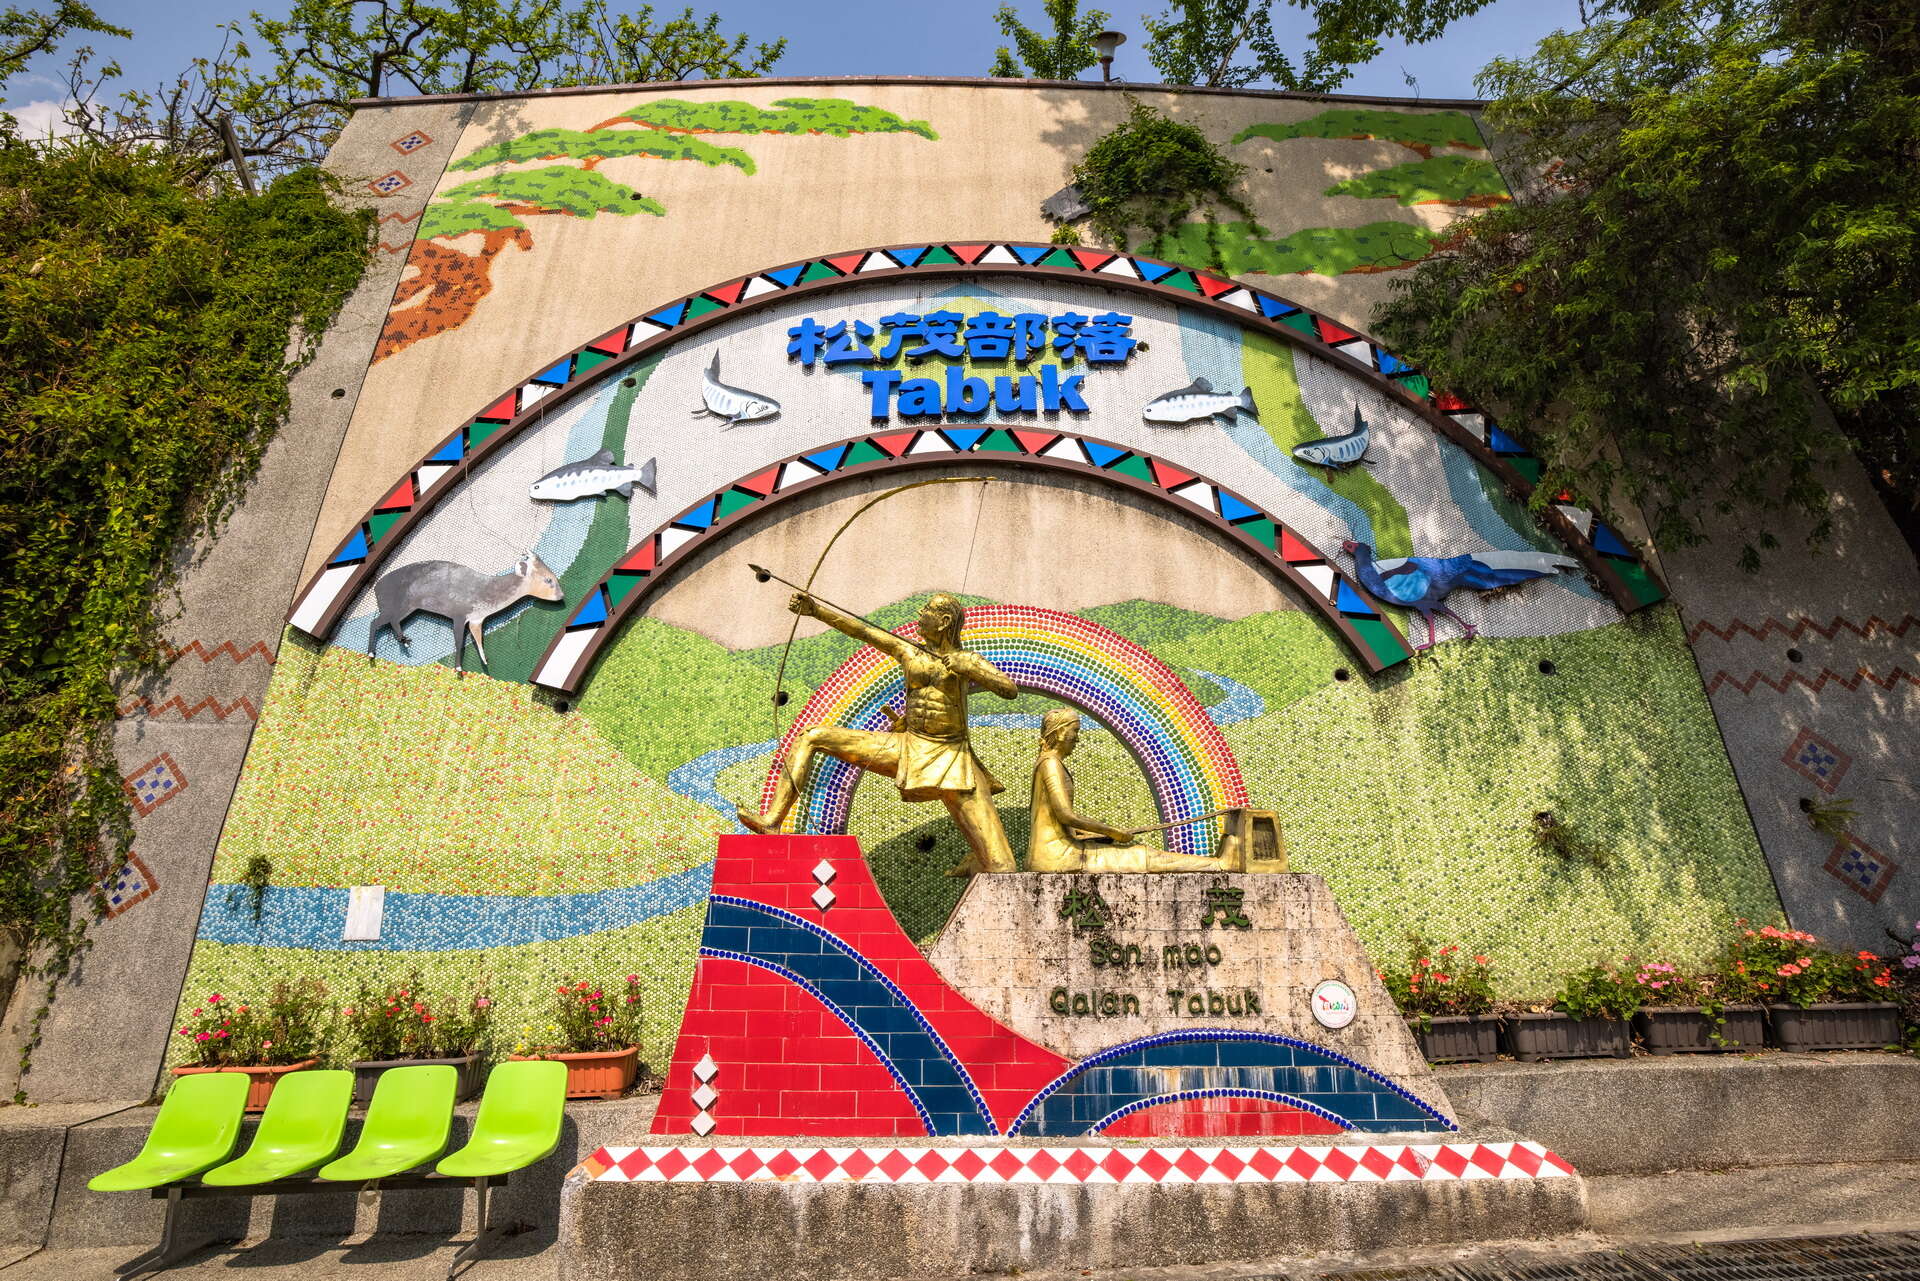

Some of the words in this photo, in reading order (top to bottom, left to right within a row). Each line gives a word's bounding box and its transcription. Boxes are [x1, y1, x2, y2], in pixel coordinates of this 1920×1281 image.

[787, 309, 1136, 365] 松茂部落
[862, 364, 1089, 419] Tabuk
[1091, 940, 1143, 965] Son
[1163, 944, 1221, 966] mao
[1050, 986, 1140, 1015] Qalan
[1167, 988, 1261, 1015] Tabuk
